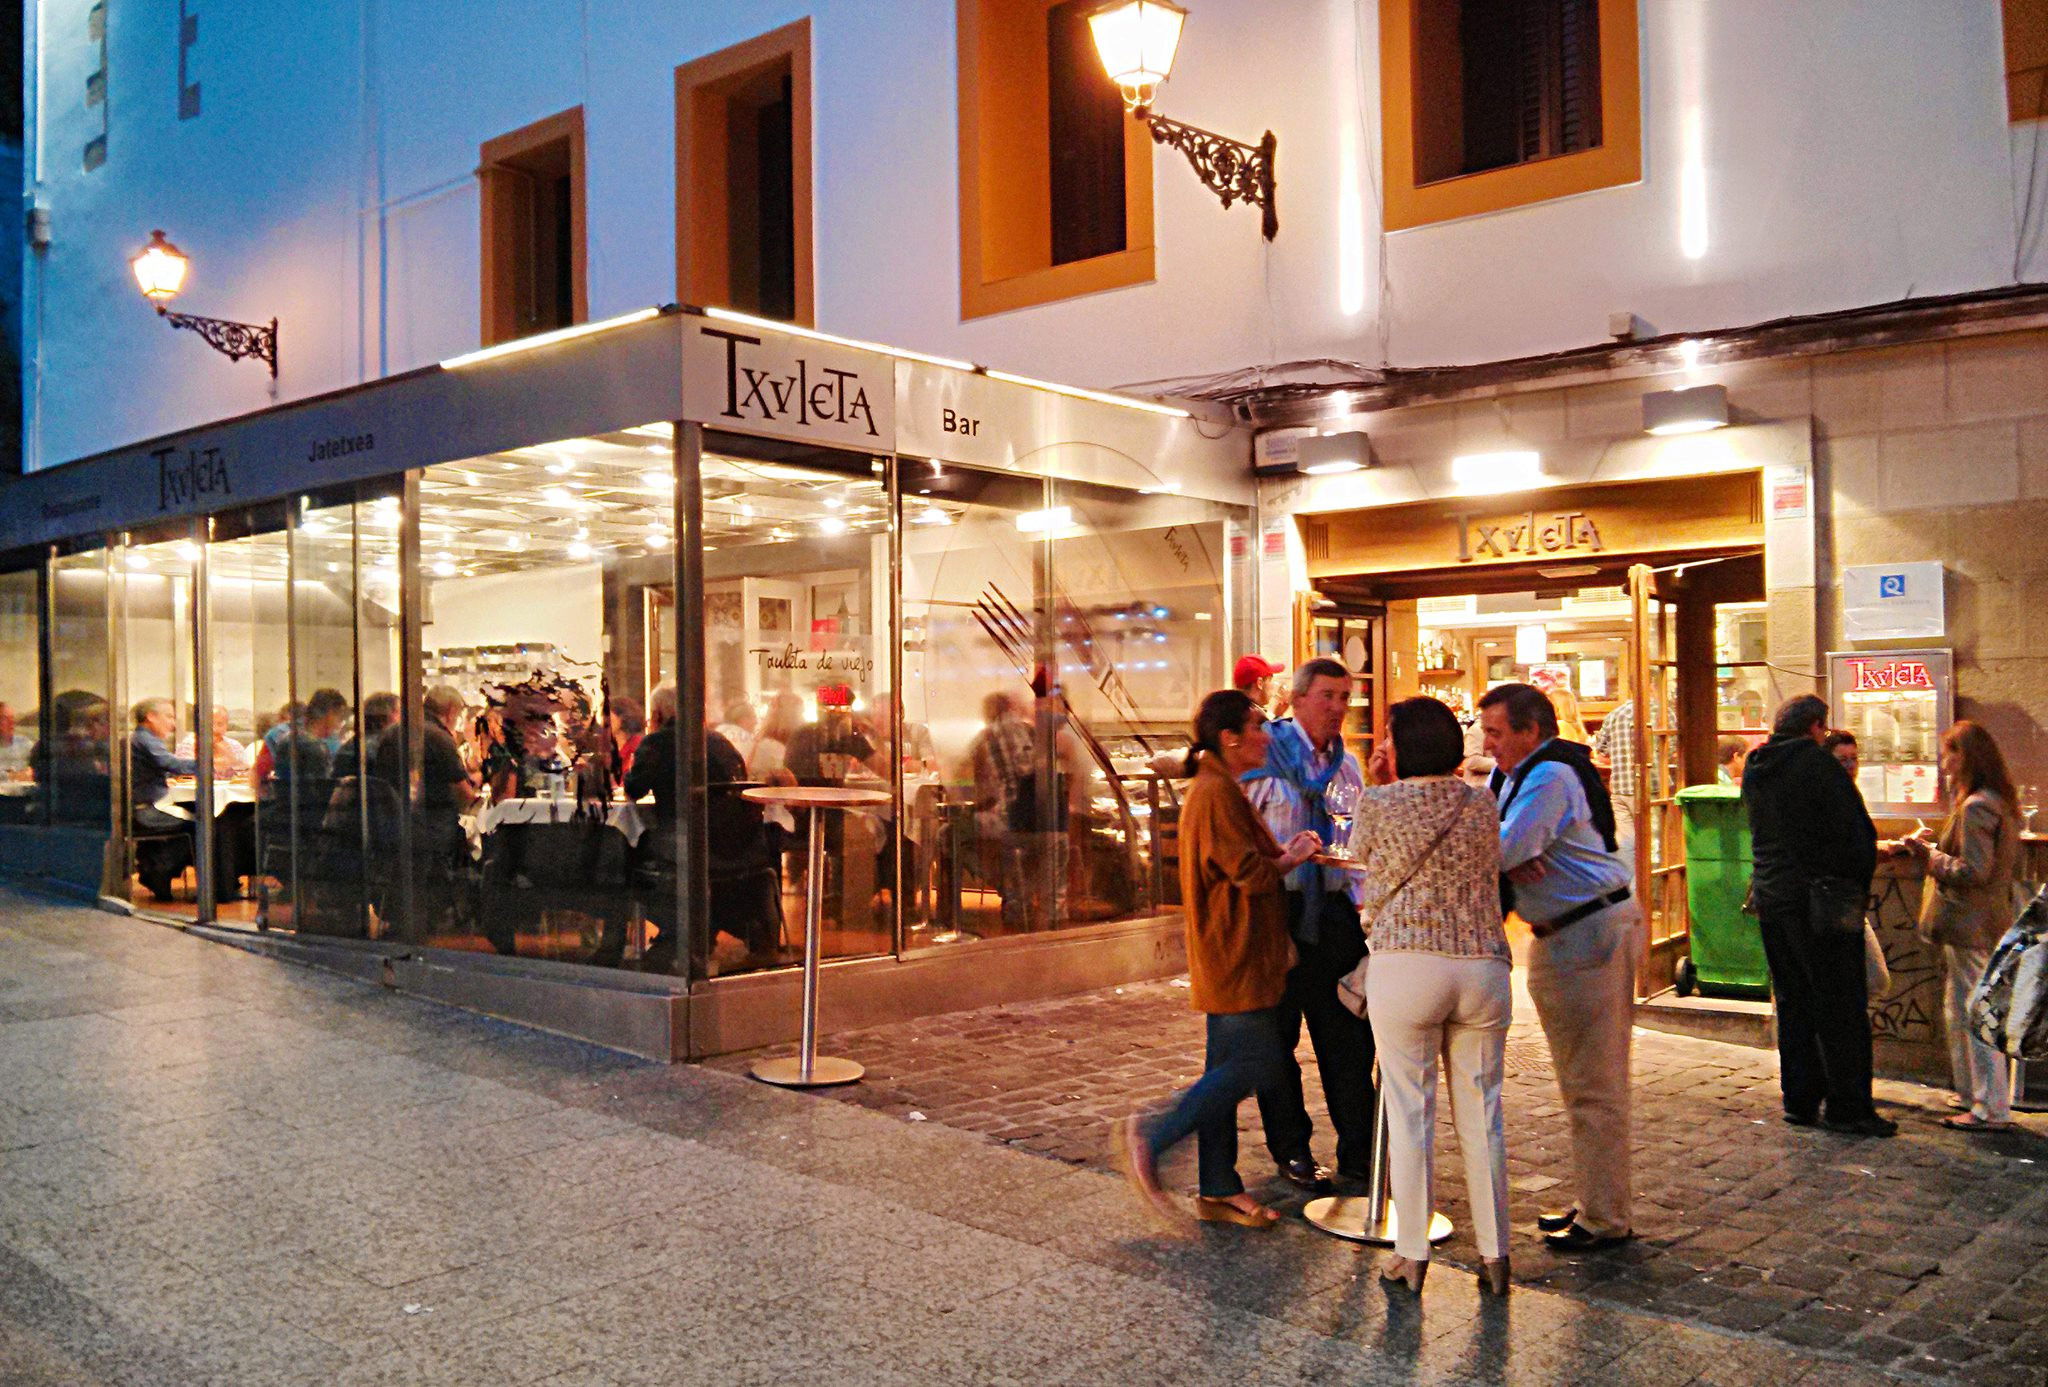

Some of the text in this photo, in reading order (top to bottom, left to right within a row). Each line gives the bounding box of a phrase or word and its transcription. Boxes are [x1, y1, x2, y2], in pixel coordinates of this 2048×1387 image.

[942, 408, 980, 436] Bar
[308, 433, 375, 463] Jatetxea
[817, 648, 833, 670] de
[841, 648, 874, 683] viejo
